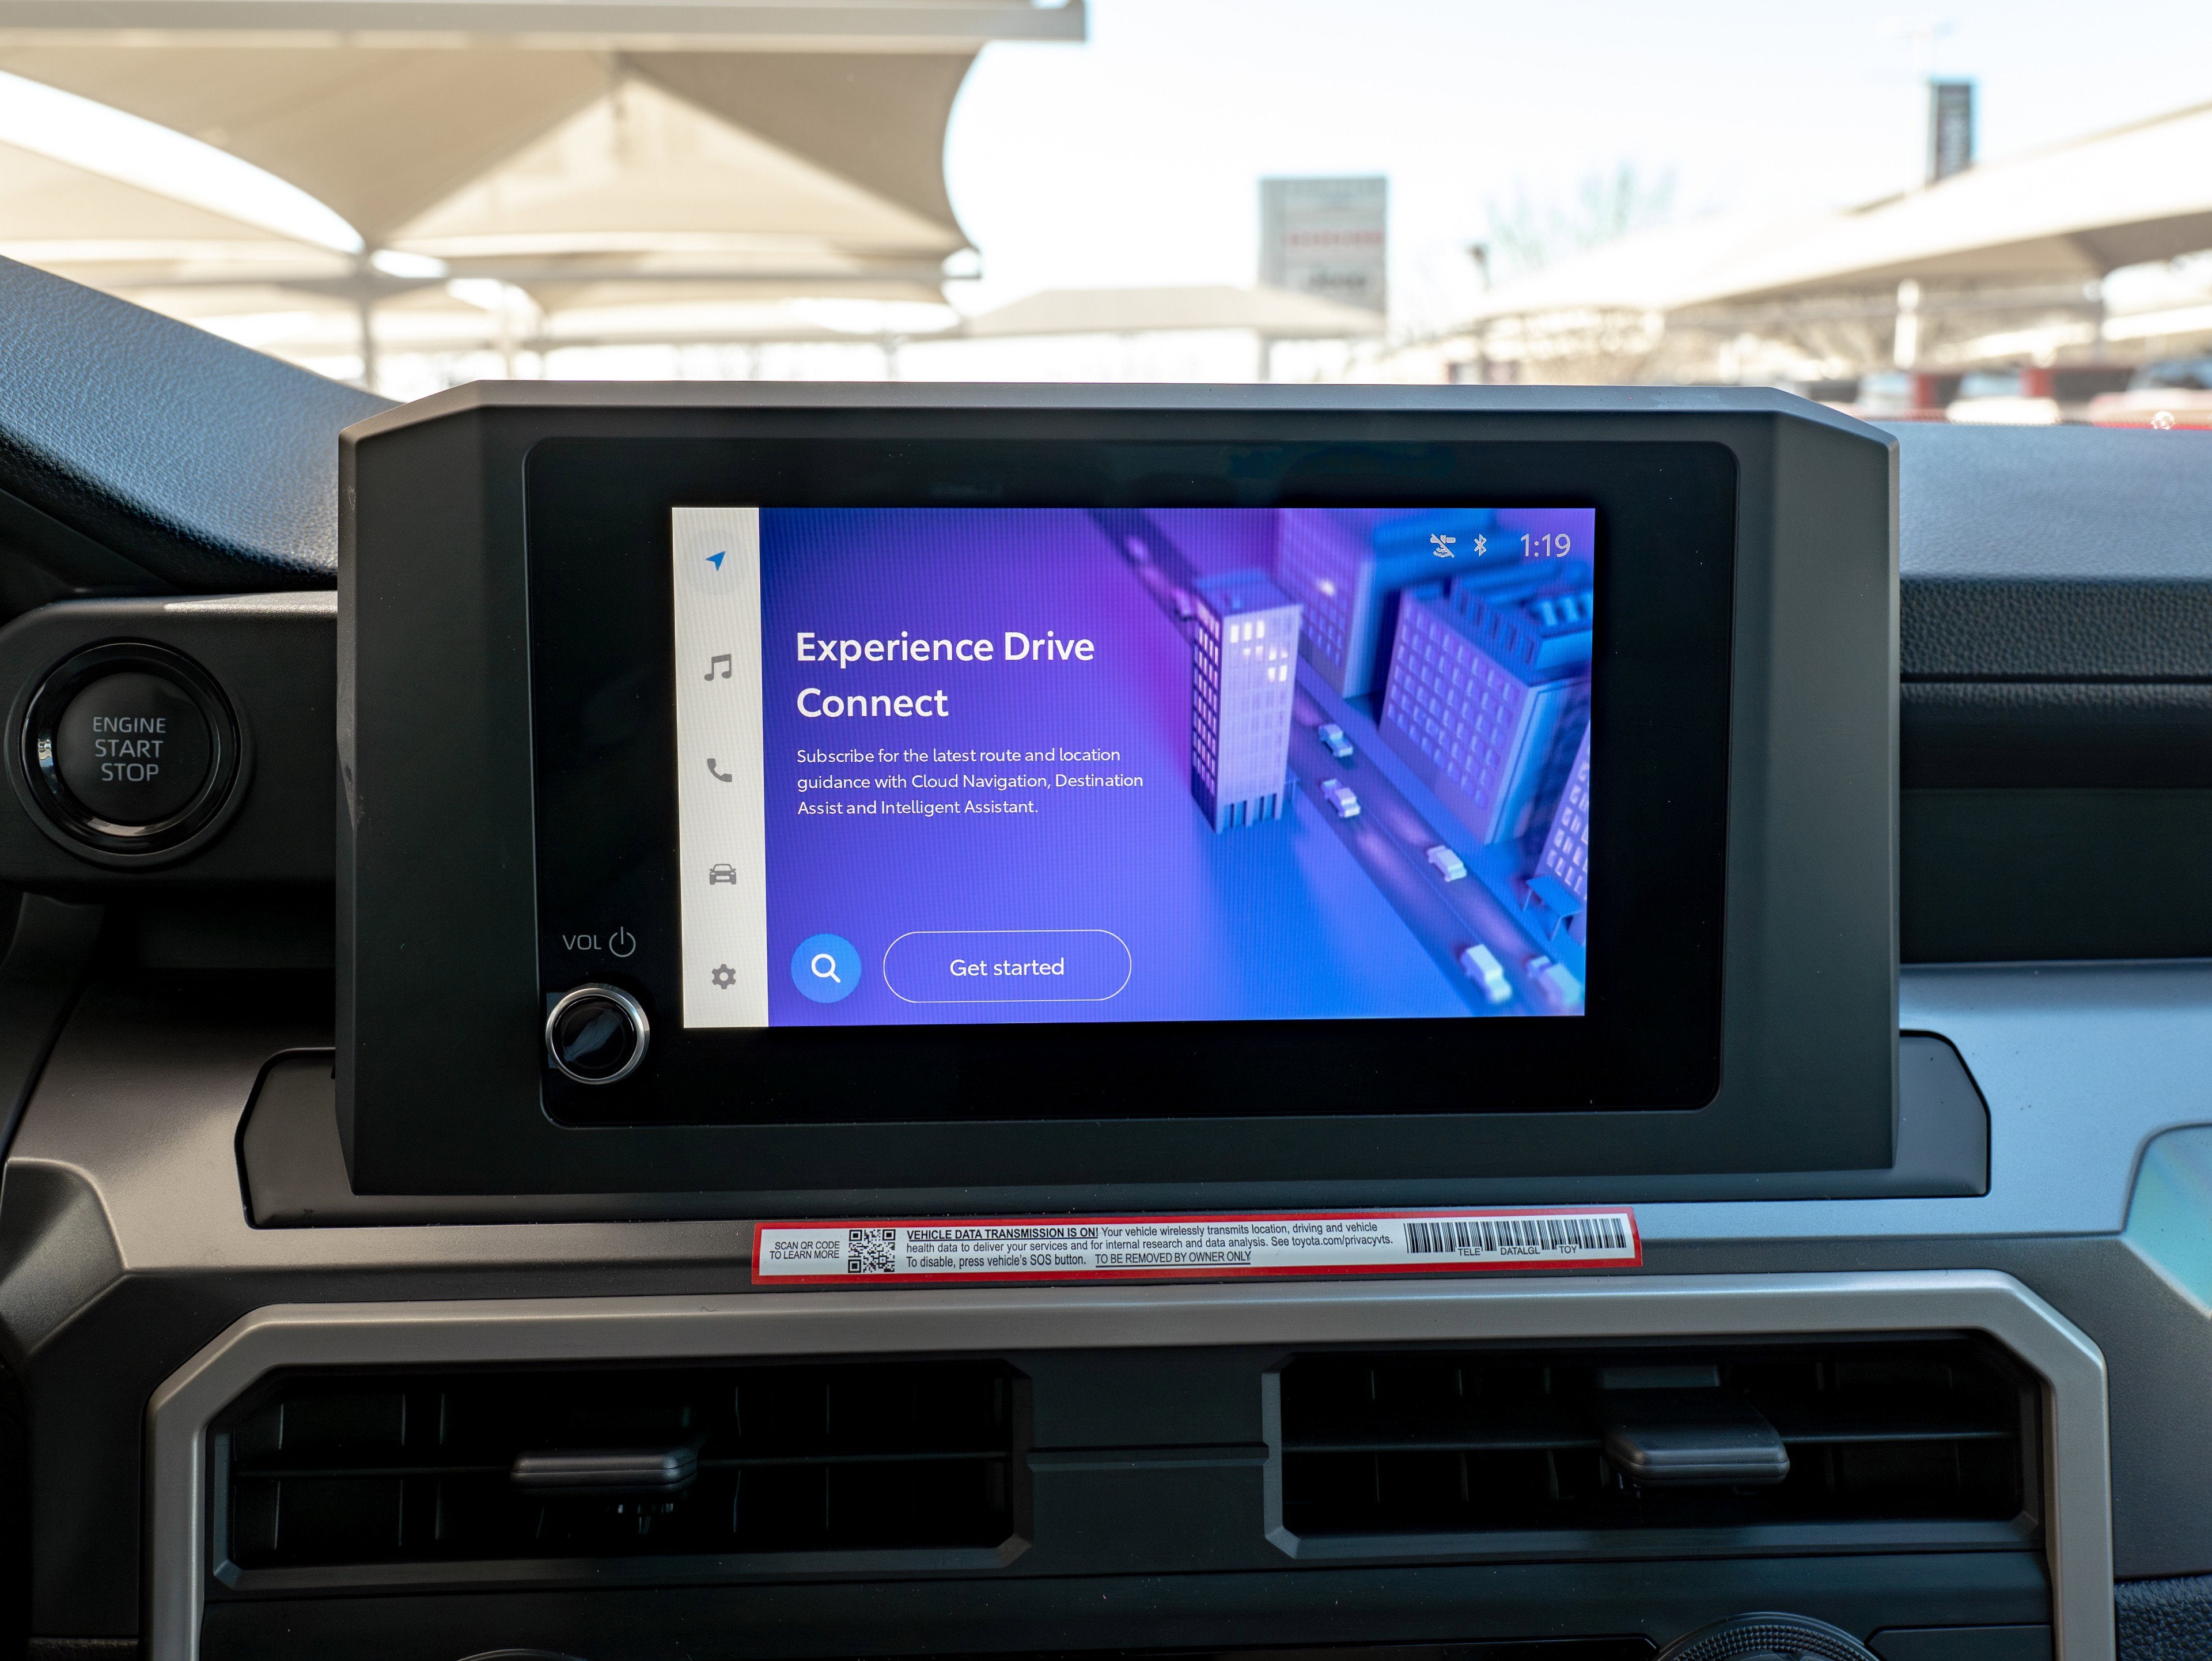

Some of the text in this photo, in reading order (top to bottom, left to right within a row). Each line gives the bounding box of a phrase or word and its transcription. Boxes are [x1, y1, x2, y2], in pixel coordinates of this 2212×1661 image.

[1520, 534, 1571, 558] 1:19
[797, 631, 1095, 669] Experience Drive
[797, 687, 949, 718] Connect
[93, 717, 166, 733] ENGINE
[94, 739, 164, 758] START
[797, 748, 1121, 763] Subscribe for the latest route and location
[101, 764, 159, 782] STOP
[797, 774, 1144, 792] guidance with Cloud Navigation, Destination
[797, 799, 1039, 818] Assist and Intelligent Assistant.
[563, 935, 601, 950] VOL
[949, 958, 1065, 978] Get started
[907, 1223, 1377, 1240] VEHICLE DATA TRANSMISSION IS ON! Your vehicle wirelessly transmits location, driving and vehicle
[775, 1241, 840, 1250] SCAN QR CODE
[906, 1235, 1393, 1254] health data to deliver your services and for internal research and data analysis. See toyota.com/privacyvts.
[1458, 1245, 1577, 1256] TELE DATALGL TOY
[770, 1250, 840, 1259] TO LEARN MORE
[906, 1256, 918, 1267] To
[920, 1256, 956, 1269] disable,
[959, 1257, 984, 1269] press
[1030, 1255, 1051, 1265] SOS
[1054, 1254, 1087, 1265] button.
[1095, 1254, 1108, 1264] TO
[1111, 1254, 1123, 1263] BE
[1125, 1253, 1173, 1263] REMOVED
[1174, 1252, 1186, 1262] BY
[1189, 1252, 1225, 1262] OWNER
[1226, 1251, 1252, 1261] ONLY
